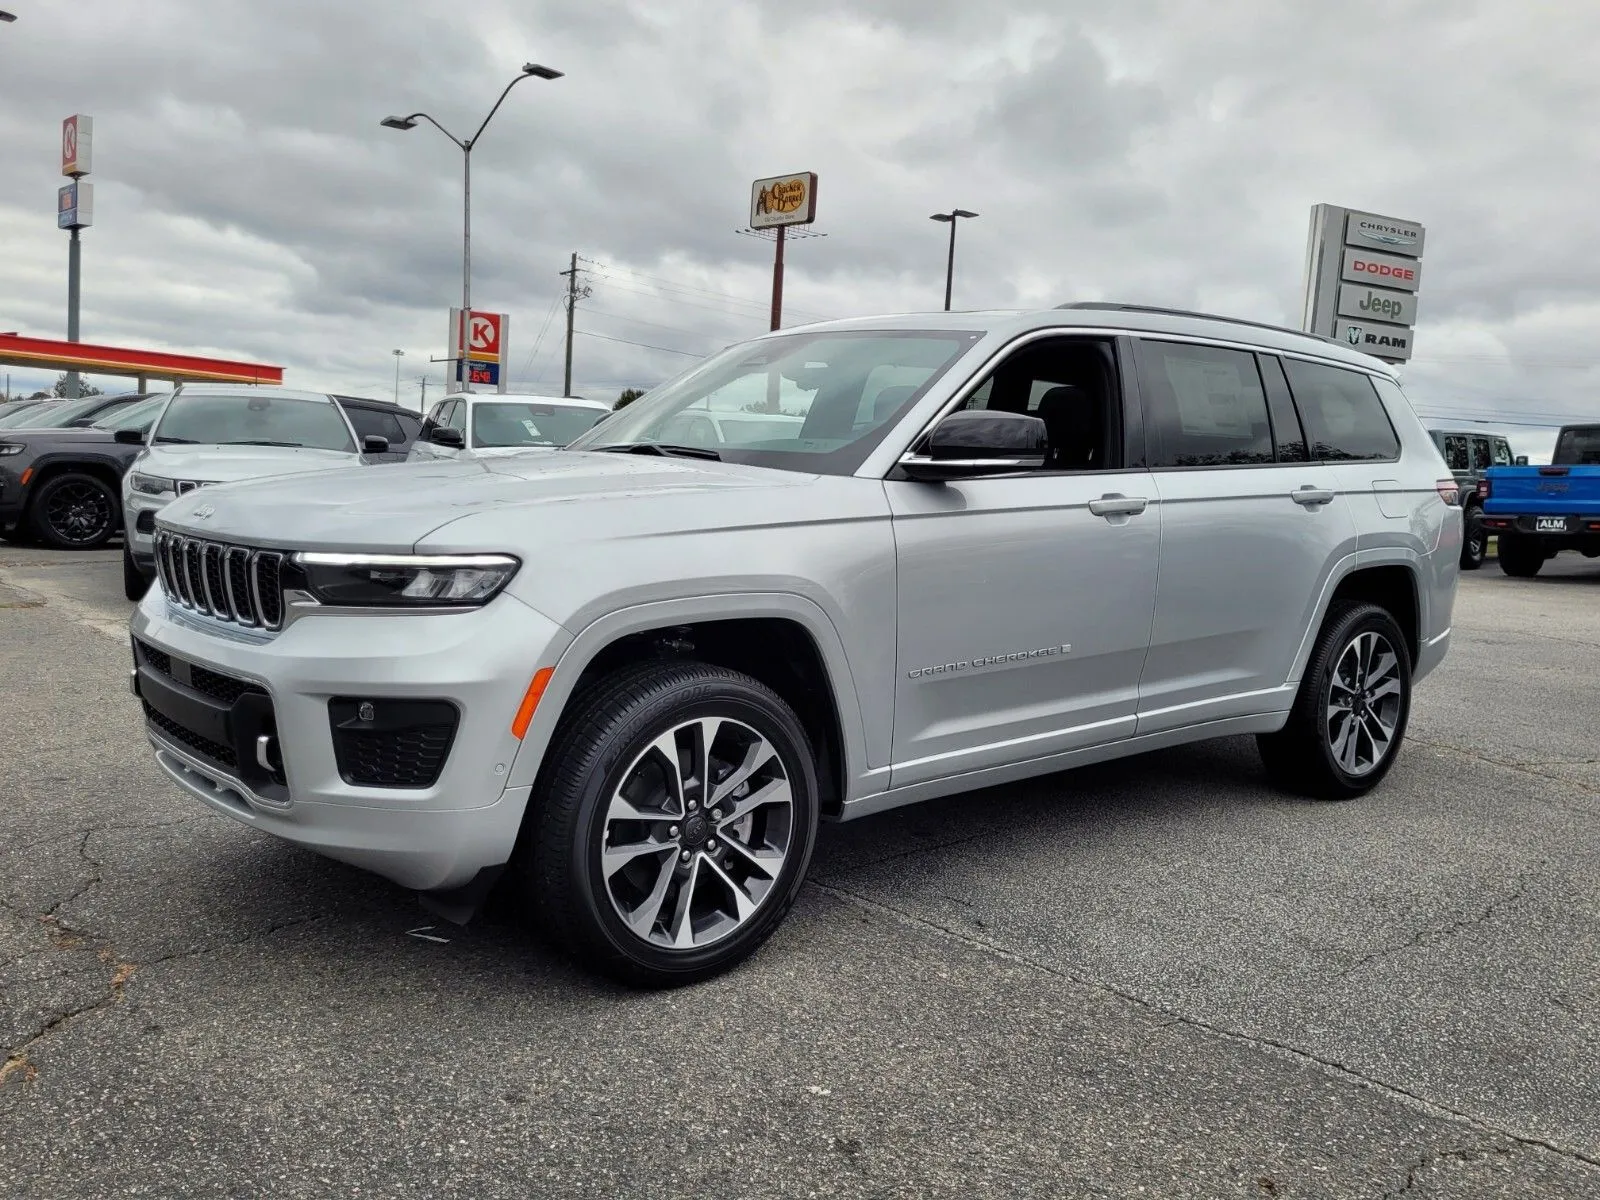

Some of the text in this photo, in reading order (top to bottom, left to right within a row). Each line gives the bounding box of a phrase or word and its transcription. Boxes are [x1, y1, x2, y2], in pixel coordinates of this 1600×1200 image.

[1360, 221, 1417, 238] CHRYSLER
[1353, 260, 1414, 281] DODGE
[1359, 291, 1402, 319] Jeep
[473, 323, 491, 346] K
[1364, 333, 1407, 349] RAM
[1539, 519, 1564, 528] ALM
[908, 661, 968, 679] GRAND
[972, 646, 1057, 668] CHEROKEE
